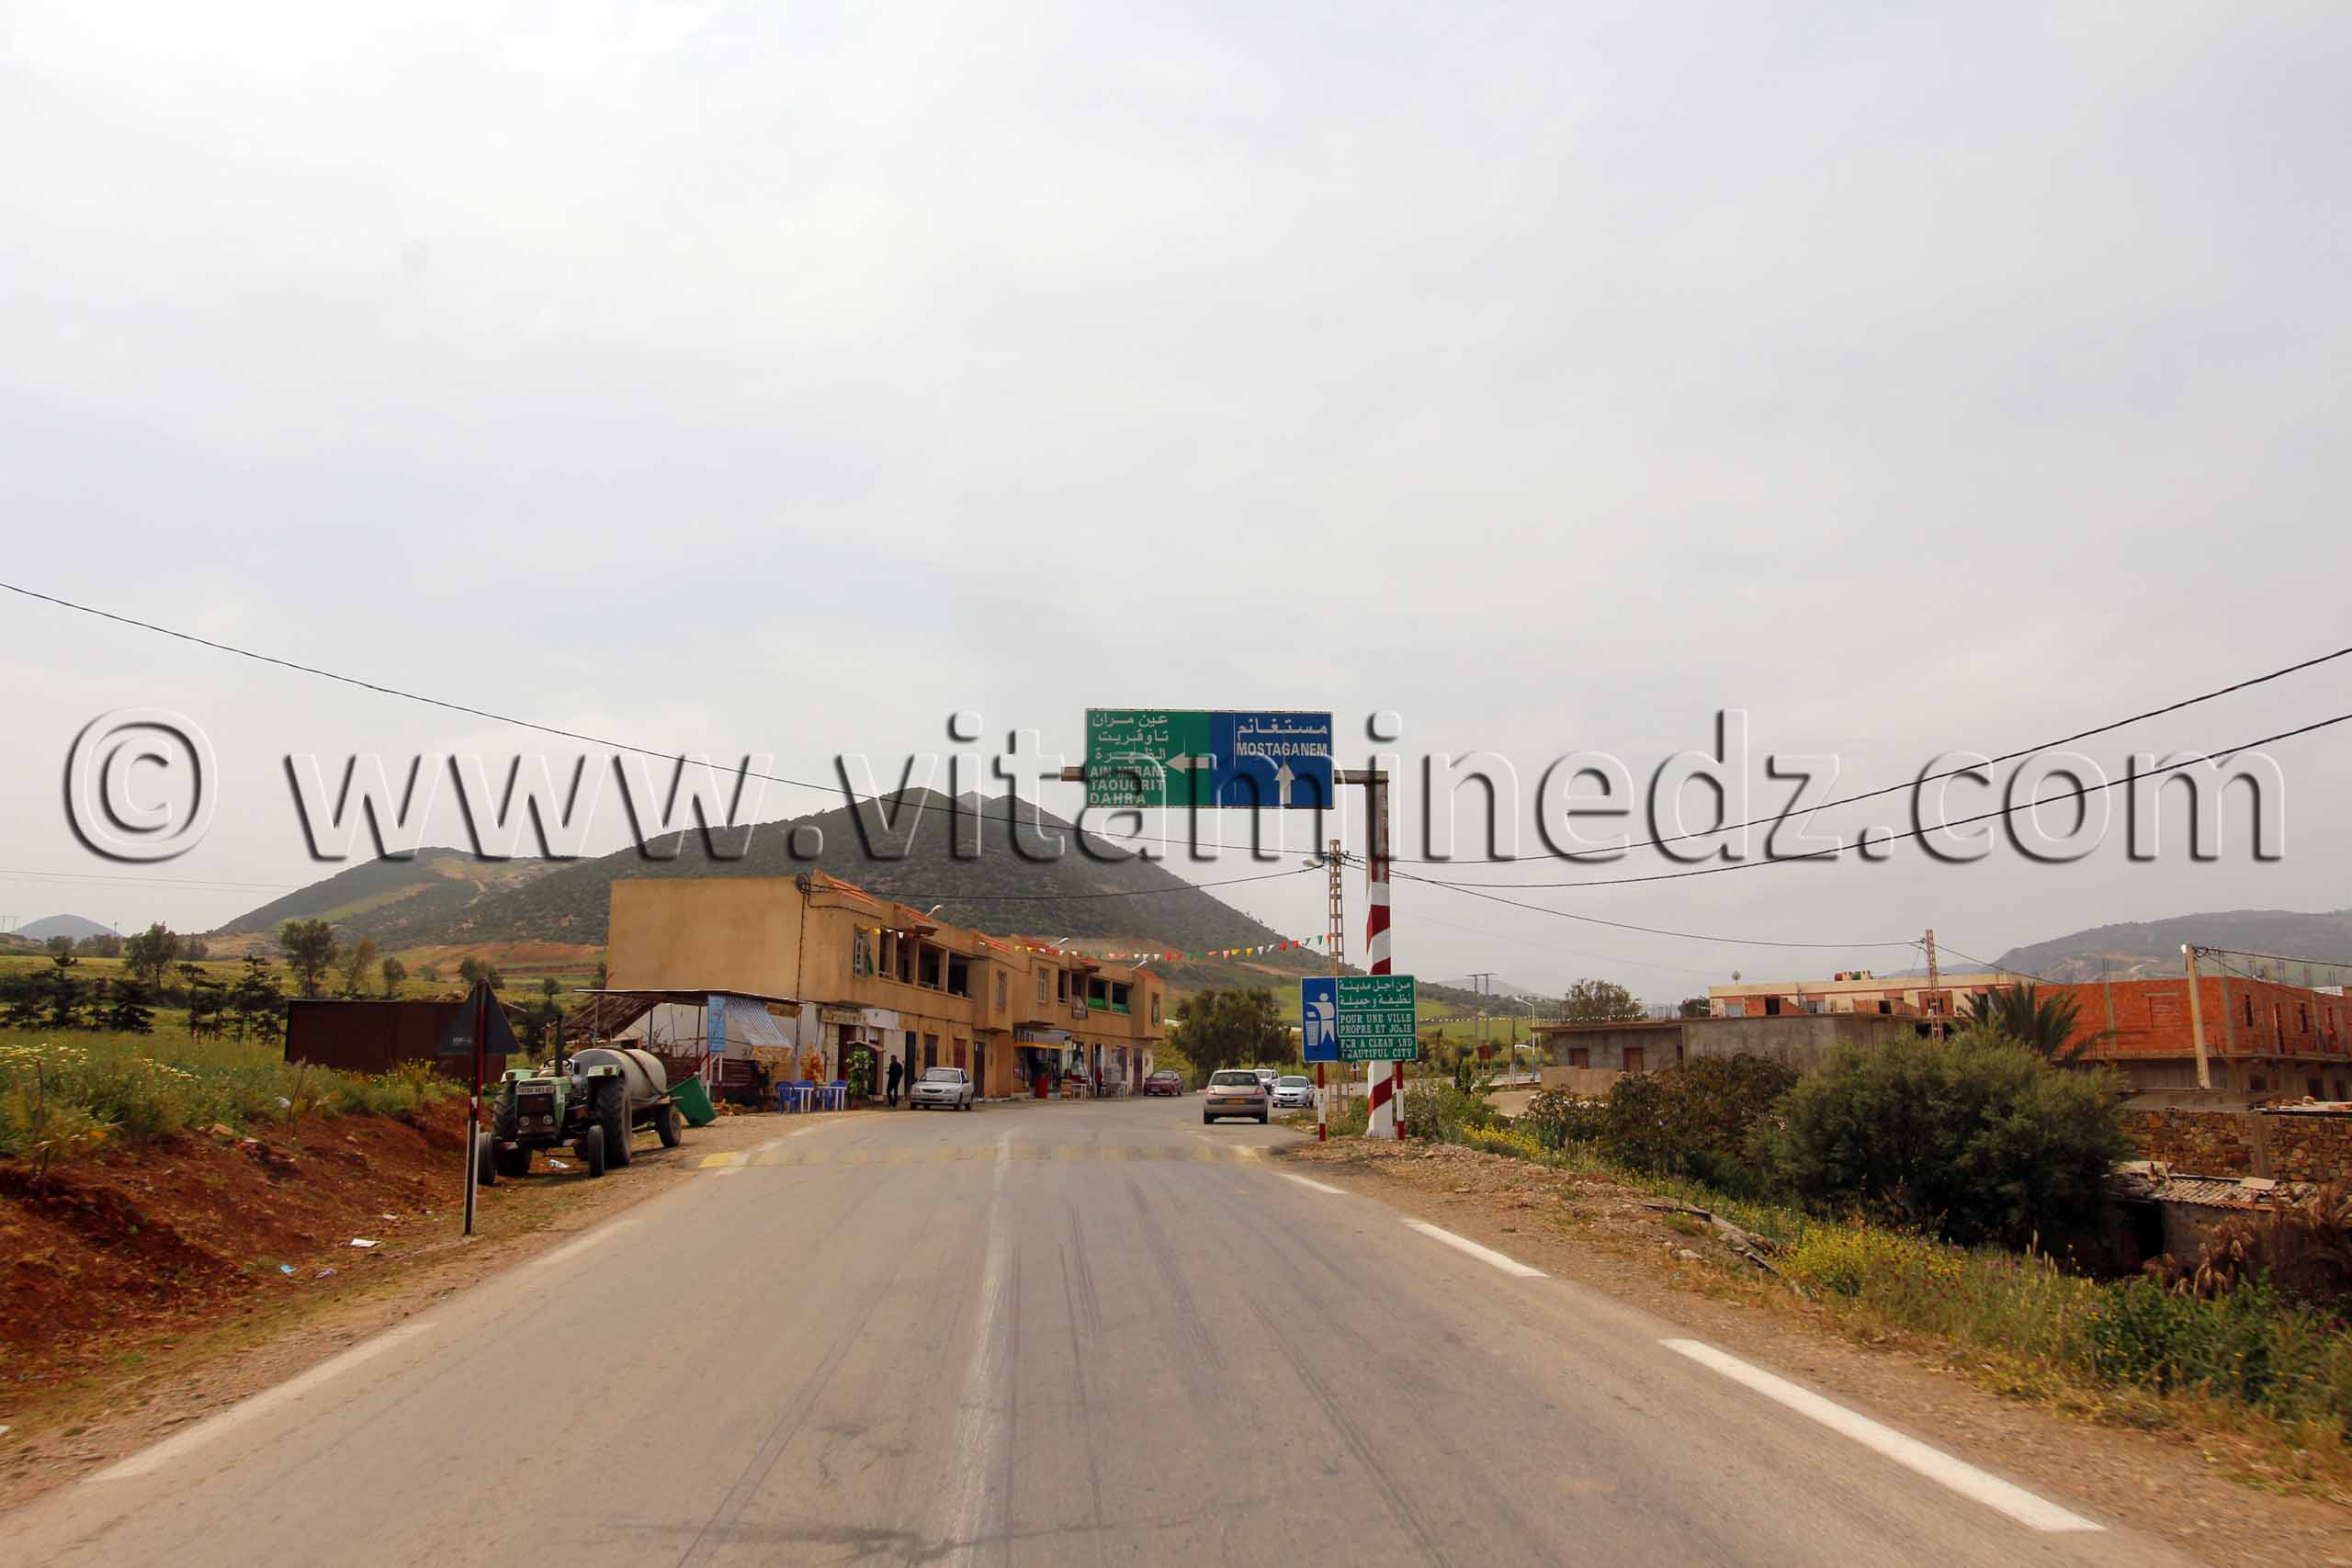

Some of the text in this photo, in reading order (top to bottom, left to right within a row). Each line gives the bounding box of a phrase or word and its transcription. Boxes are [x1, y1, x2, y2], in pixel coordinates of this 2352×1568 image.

[1092, 712, 1169, 728] عين مران
[1238, 717, 1328, 741] مستغانم
[1237, 742, 1328, 757] MOSTAGANEM
[1090, 792, 1146, 804] DAHRA
[1340, 1013, 1411, 1023] POUR UNE VILLE
[1340, 1024, 1372, 1034] PROPRE
[1374, 1024, 1385, 1033] ET
[1341, 1038, 1413, 1048] FOR A CLEAN AND
[1392, 1048, 1412, 1058] CITY
